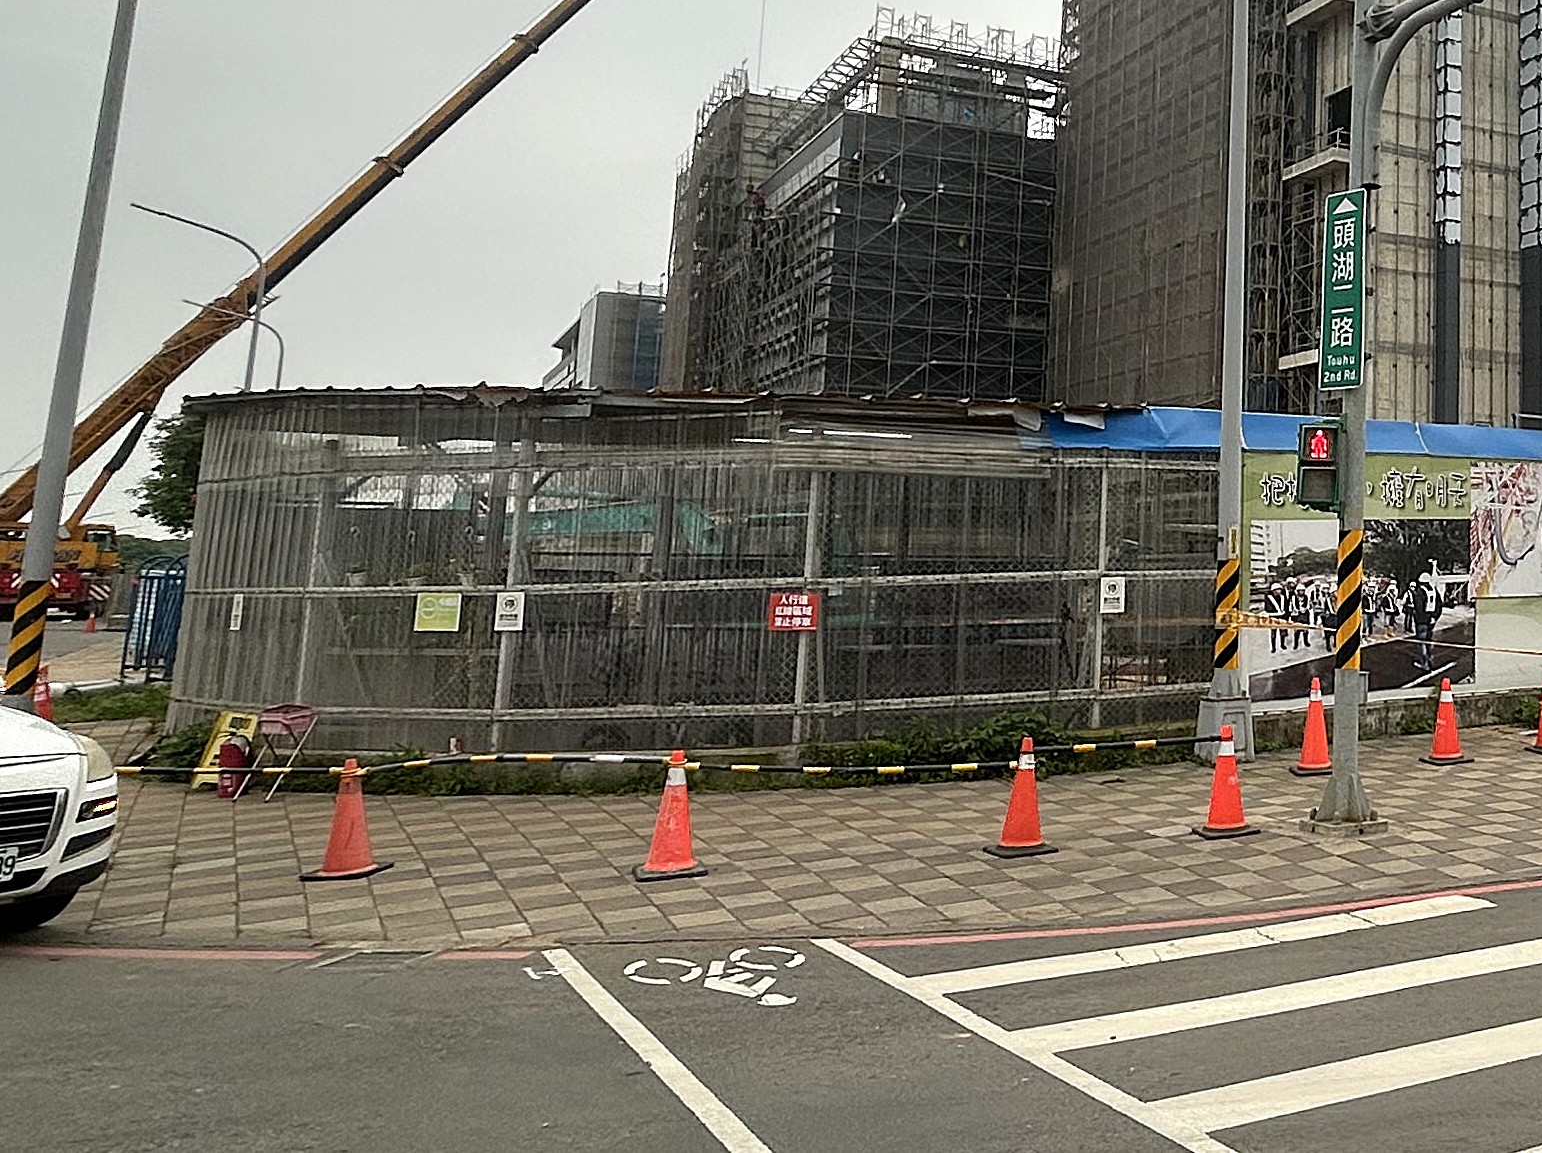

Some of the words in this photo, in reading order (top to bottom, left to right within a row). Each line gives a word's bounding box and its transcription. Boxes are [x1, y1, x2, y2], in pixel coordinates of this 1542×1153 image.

[1330, 217, 1356, 348] 頭湖二路
[1326, 354, 1356, 367] Touhu
[1323, 370, 1342, 383] 2nd
[0, 855, 16, 876] 9
